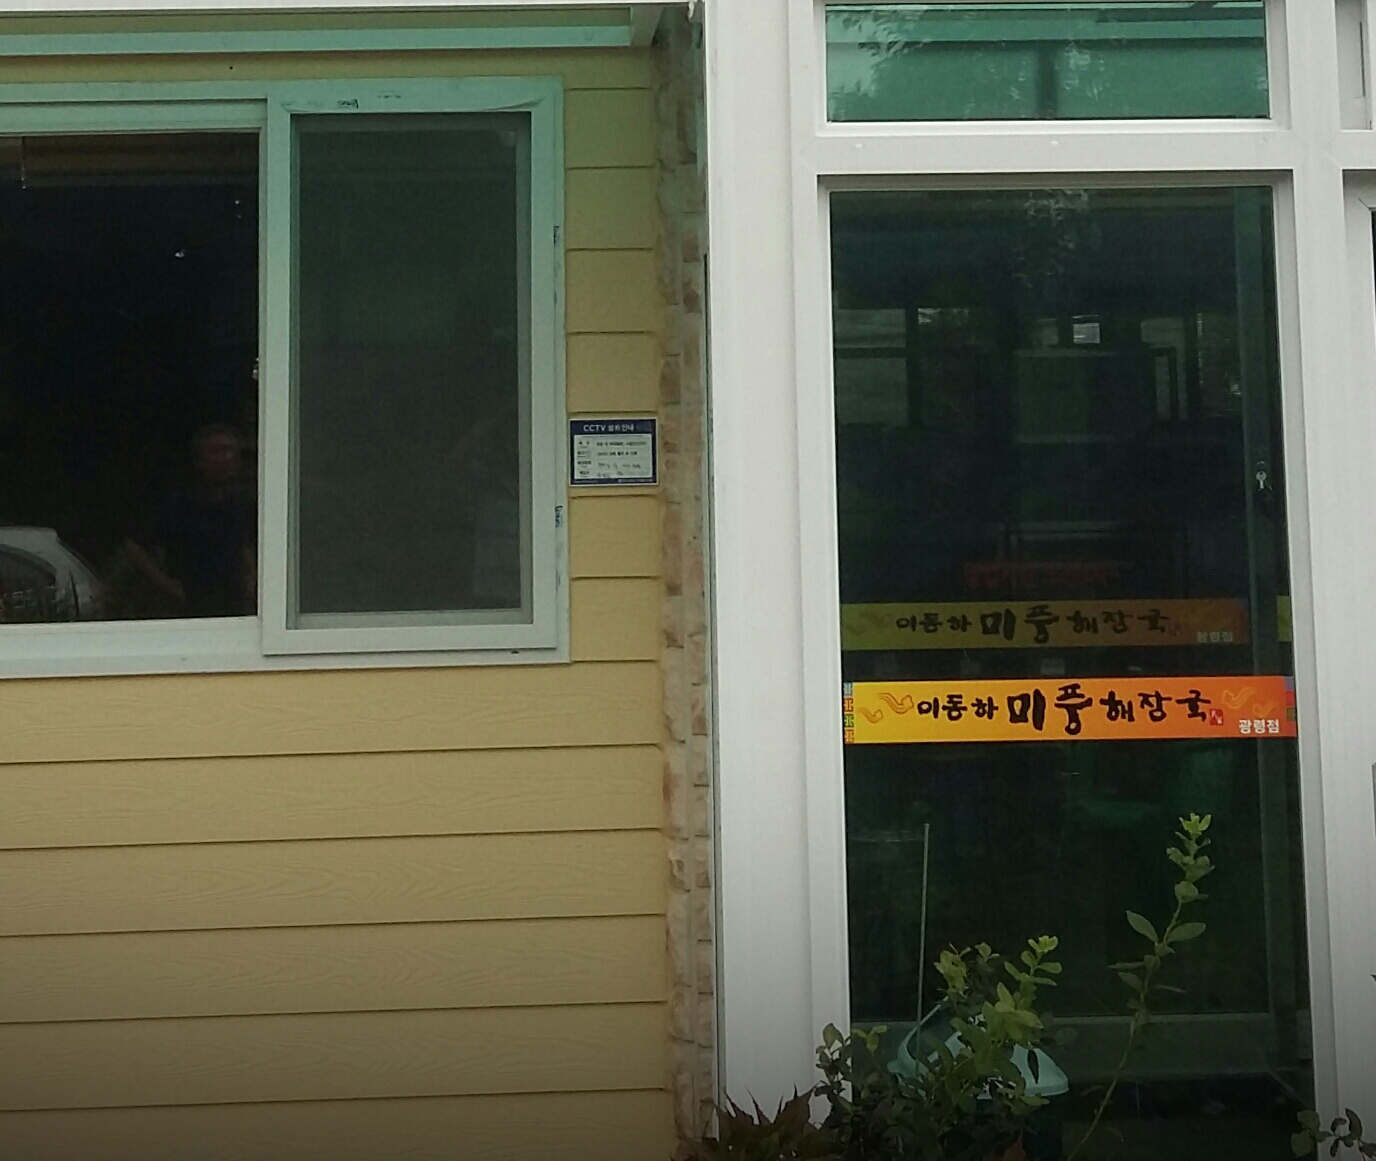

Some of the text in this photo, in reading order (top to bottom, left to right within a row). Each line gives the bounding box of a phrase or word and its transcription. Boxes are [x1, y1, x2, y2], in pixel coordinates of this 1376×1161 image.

[583, 424, 606, 432] CCTV
[917, 694, 999, 721] 이동하
[1007, 683, 1093, 735] 미풍
[1099, 690, 1211, 722] 해장국
[1238, 718, 1280, 734] 광령점
